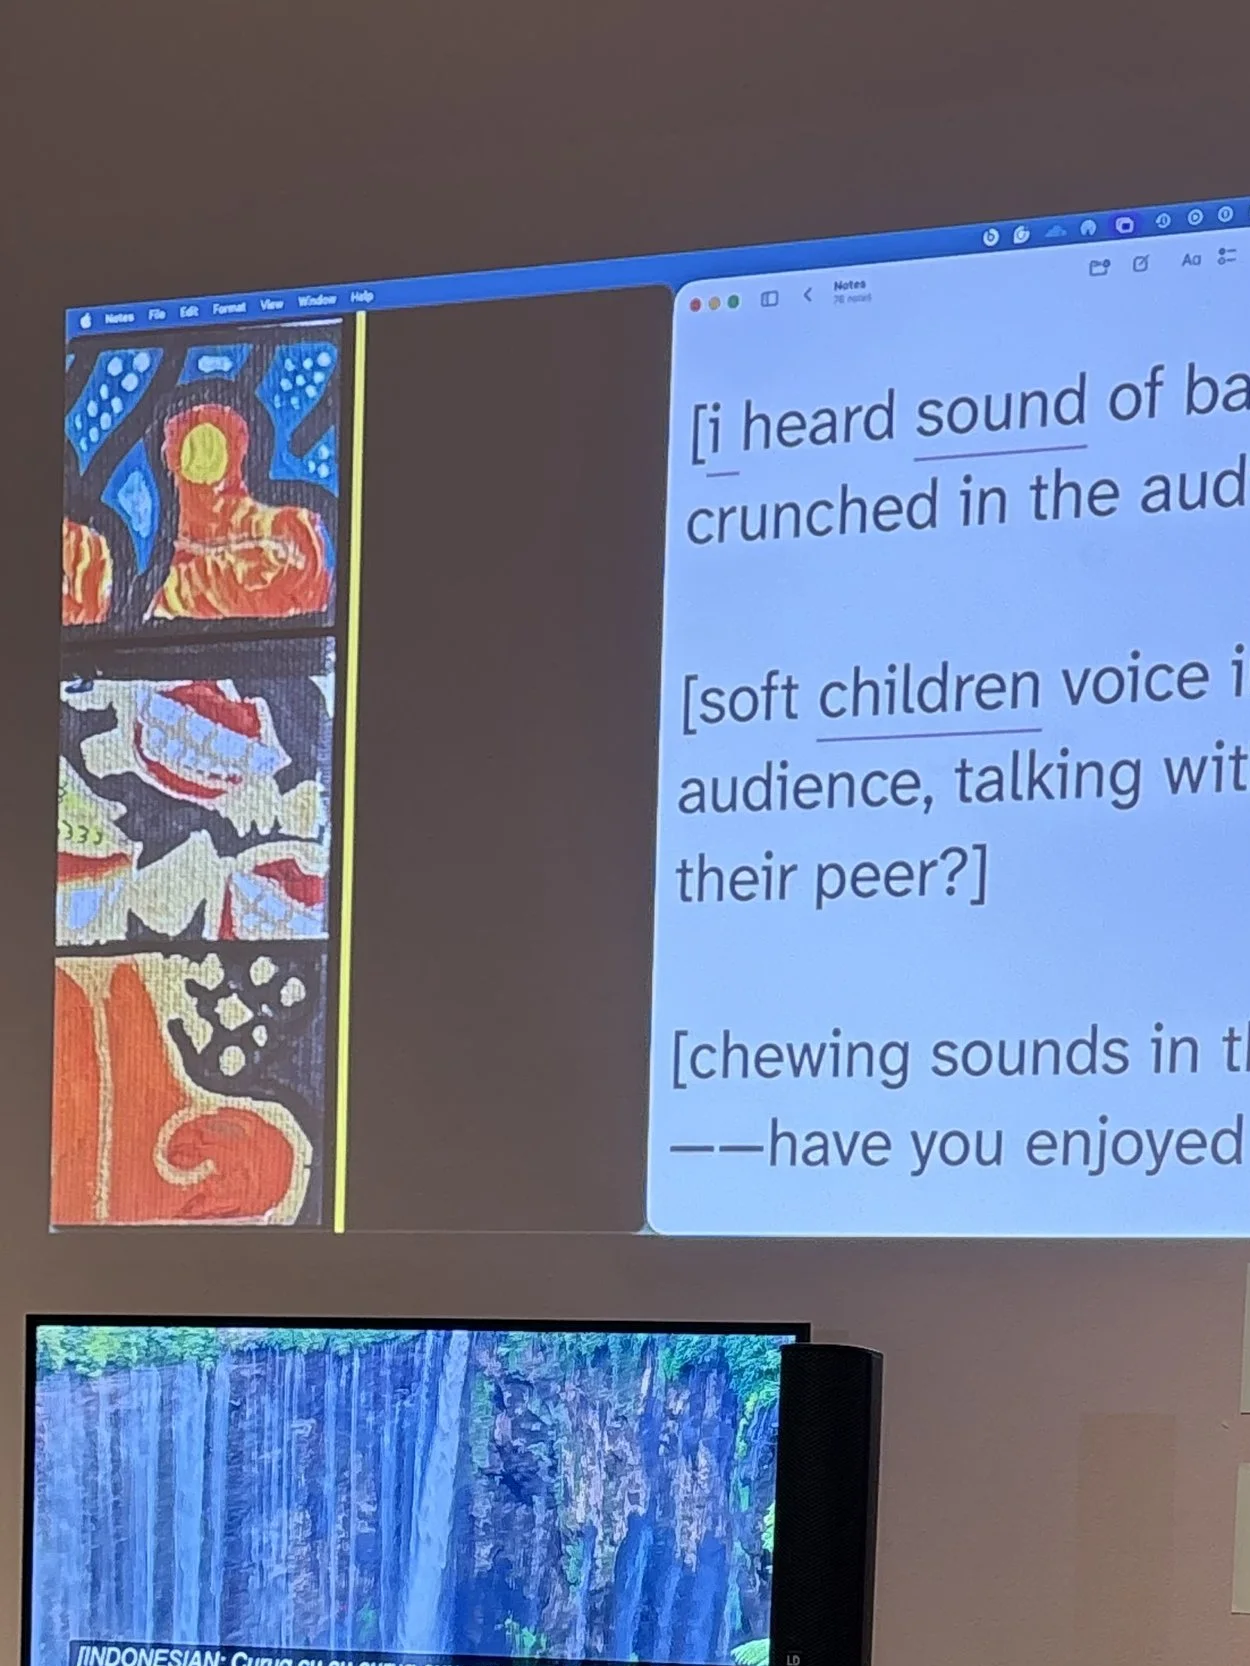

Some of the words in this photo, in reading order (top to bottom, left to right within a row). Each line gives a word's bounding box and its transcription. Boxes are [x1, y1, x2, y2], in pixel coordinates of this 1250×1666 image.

[104, 312, 135, 325] Notes
[148, 309, 167, 321] File
[179, 305, 200, 319] Edit
[212, 301, 248, 316] Format
[259, 298, 285, 312] View
[297, 293, 338, 308] Window
[350, 289, 375, 304] Help
[833, 280, 867, 291] Notes
[691, 402, 722, 466] [i
[742, 387, 897, 451] heard
[915, 371, 1088, 438] sound
[1108, 364, 1166, 422] of
[686, 475, 939, 546] crunched
[959, 474, 1008, 528] in
[1029, 467, 1120, 521] the
[681, 669, 800, 737] [soft
[819, 660, 1041, 719] children
[1062, 649, 1210, 706] voice
[677, 759, 934, 815] audience,
[954, 747, 1141, 810] talking
[675, 850, 799, 903] their
[815, 842, 988, 911] peer?]
[672, 1026, 910, 1090] [chewing
[930, 1023, 1130, 1077] sounds
[1150, 1021, 1200, 1075] in
[909, 1129, 1003, 1177] you
[1026, 1113, 1245, 1177] enjoyed
[786, 1654, 801, 1666] LD
